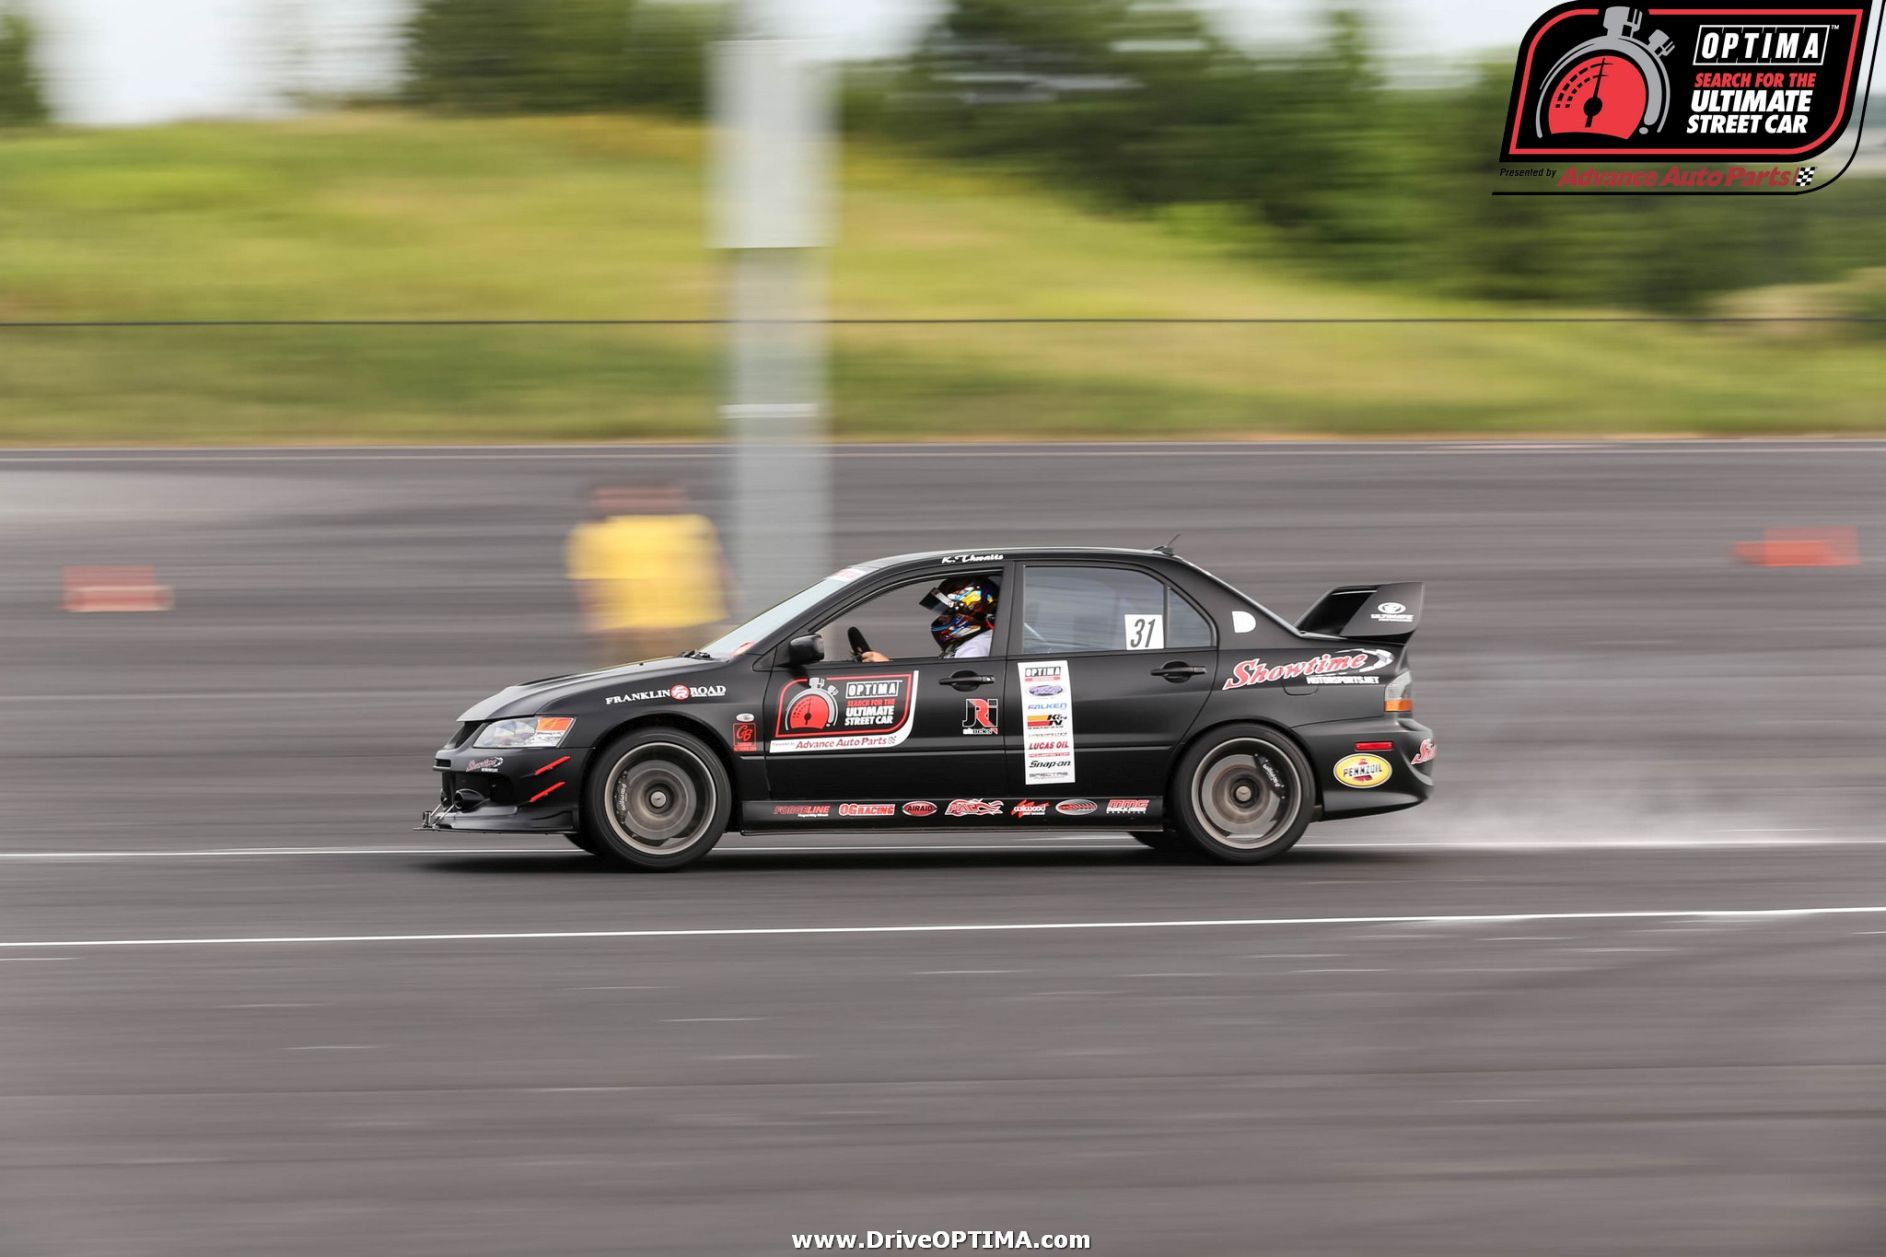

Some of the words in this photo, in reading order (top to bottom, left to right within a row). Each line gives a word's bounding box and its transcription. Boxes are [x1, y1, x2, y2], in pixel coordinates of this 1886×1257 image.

[1130, 618, 1156, 648] 31
[1222, 653, 1369, 690] Showtime
[604, 689, 671, 705] FRANKLIN
[689, 685, 726, 696] ROAD
[848, 683, 897, 697] OPTIMA
[846, 705, 896, 717] ULTIMATE
[1028, 703, 1067, 711] FALKEN
[844, 716, 875, 726] STREET
[875, 715, 893, 725] CAR
[795, 741, 835, 750] Advance
[836, 738, 860, 748] Auto
[860, 737, 887, 746] Parts
[1029, 741, 1055, 750] LUCAS
[1056, 741, 1070, 749] OIL
[1029, 760, 1072, 769] Snap-on
[1343, 764, 1383, 777] PENNZOIL
[907, 805, 934, 813] AIRAID
